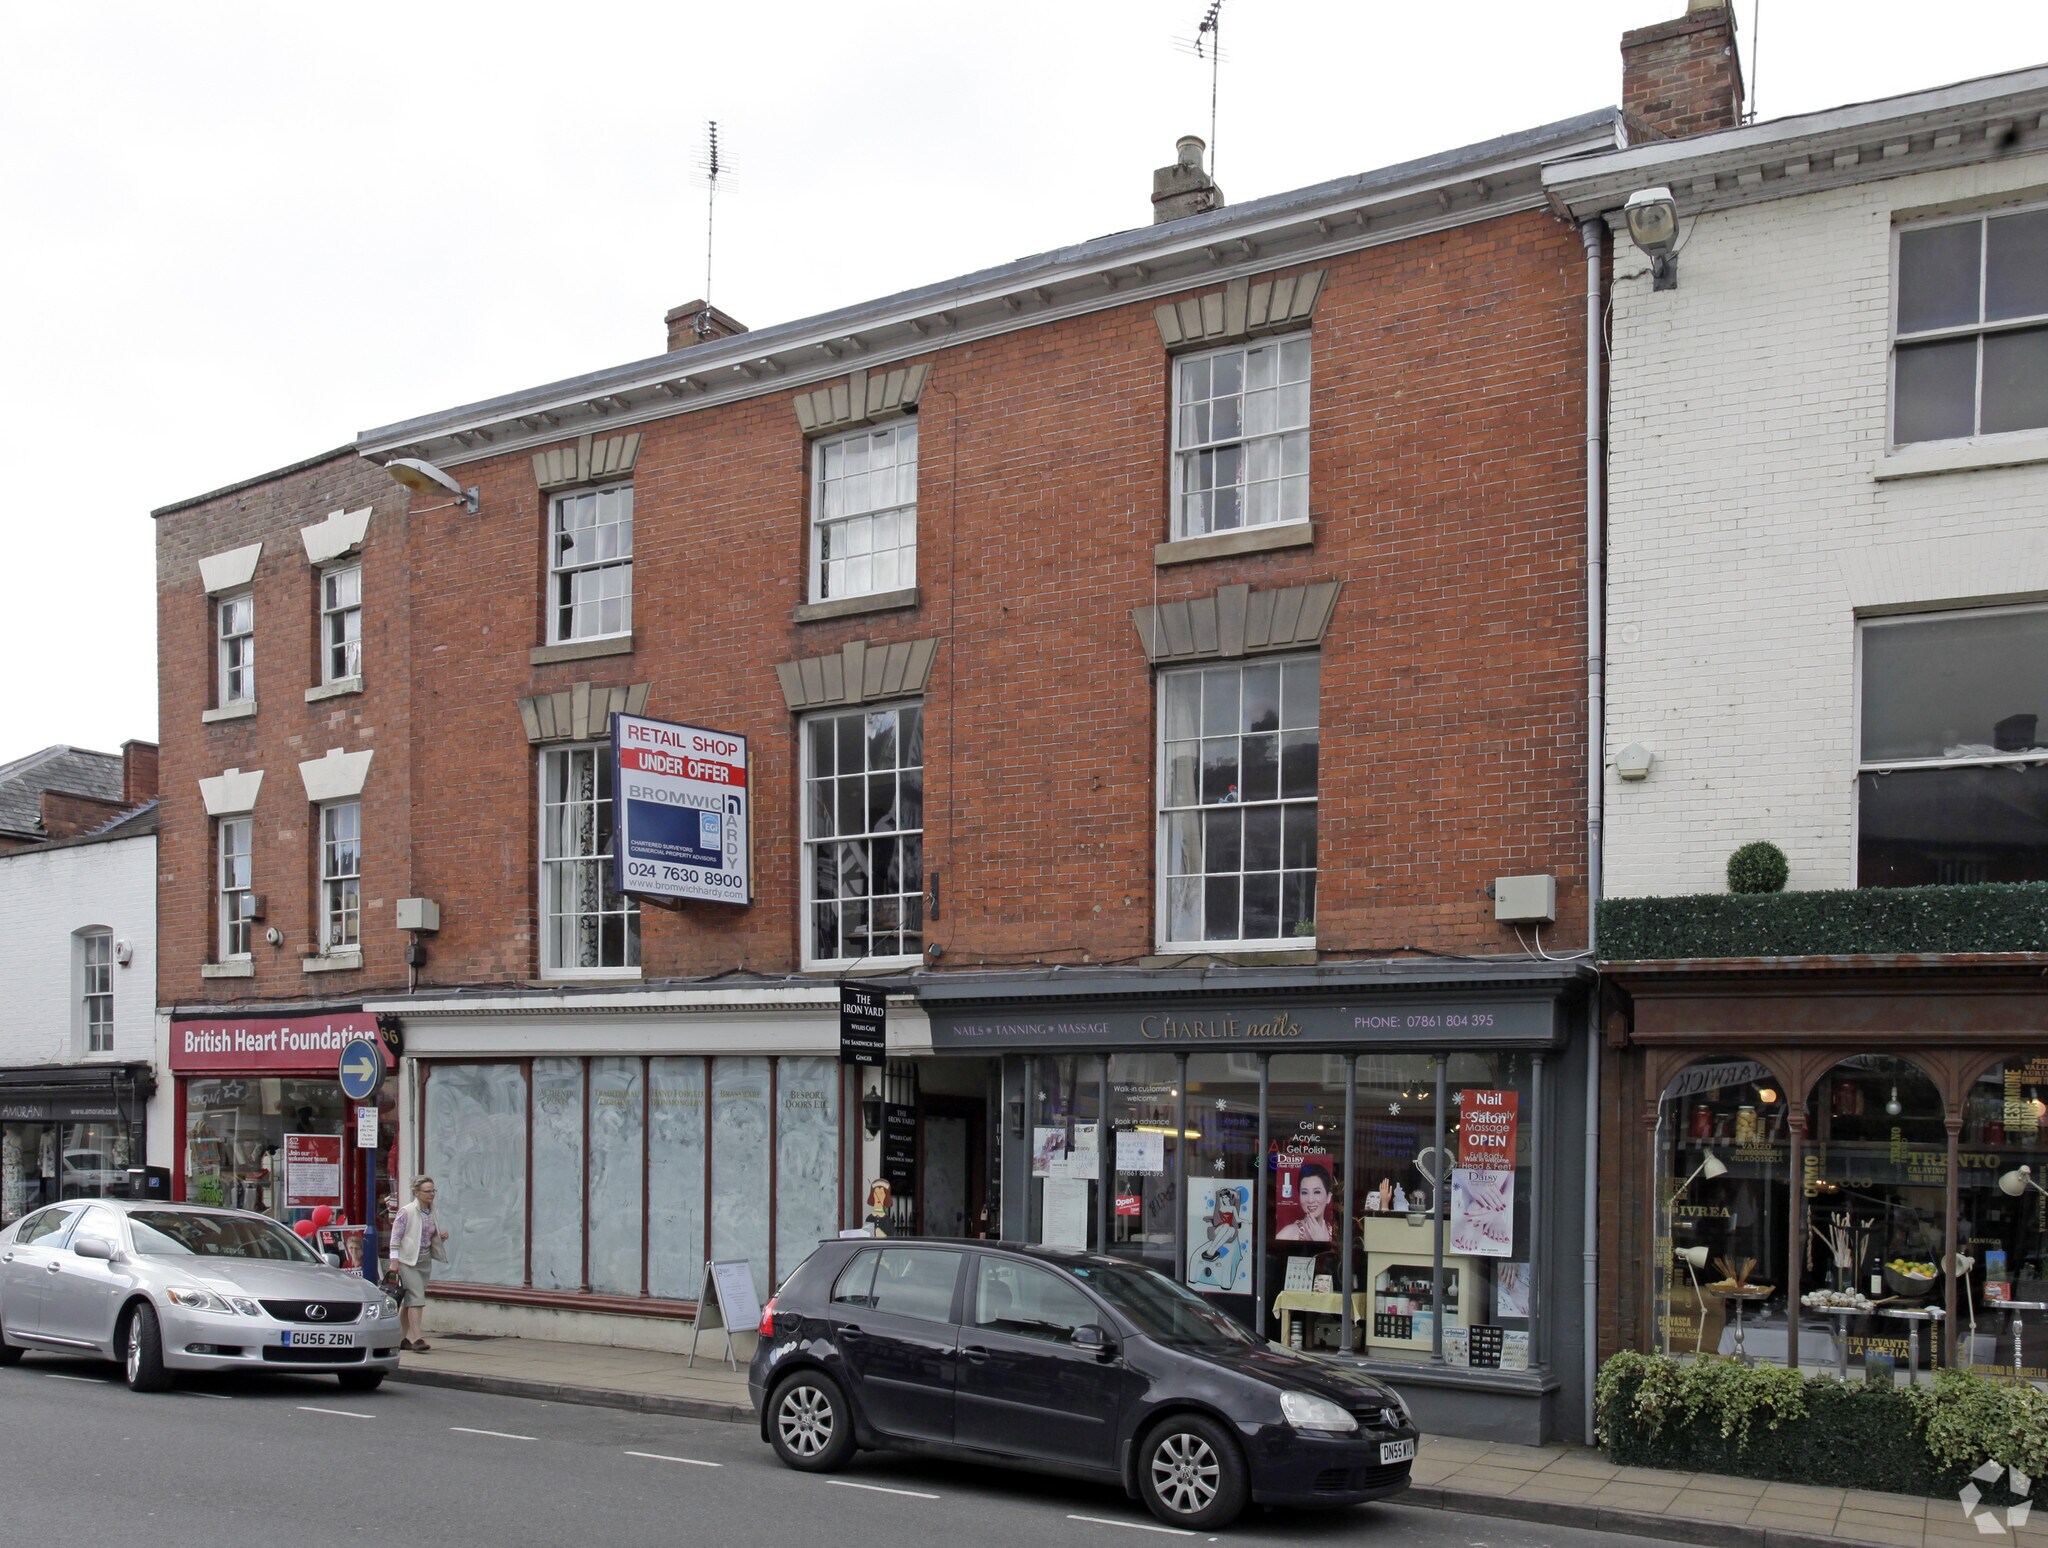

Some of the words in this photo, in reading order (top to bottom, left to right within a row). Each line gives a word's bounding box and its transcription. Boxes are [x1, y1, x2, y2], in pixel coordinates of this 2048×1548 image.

[628, 724, 686, 748] RETAIL
[692, 736, 738, 756] SHOP
[639, 752, 683, 775] UNDER
[688, 760, 729, 782] OFFER
[631, 840, 663, 849] CHARTERED
[663, 843, 694, 853] SURVEYORS
[631, 846, 665, 856] COMMERCIAL
[665, 850, 693, 859] PROPERTY
[692, 854, 717, 862] ADVISORS
[628, 862, 657, 878] 024
[662, 866, 699, 883] 7630
[704, 872, 743, 888] 8900
[628, 879, 743, 900] www.bromwichhardy.com
[855, 994, 871, 1005] THE
[843, 1003, 863, 1015] IRON
[864, 1006, 884, 1017] YARD
[1141, 1015, 1239, 1039] CHARLIE
[1246, 1012, 1302, 1037] nails
[1354, 1016, 1401, 1028] PHONE:
[1407, 1015, 1441, 1027] 07861
[1446, 1015, 1468, 1027] 804
[1472, 1014, 1493, 1026] 395
[381, 1027, 399, 1044] 66
[953, 1025, 984, 1037] NAILS
[994, 1023, 1046, 1036] TANNING
[1057, 1022, 1110, 1034] MASSAGE
[184, 1028, 231, 1053] British
[235, 1029, 277, 1051] Heart
[851, 1039, 873, 1047] SANDWICH
[855, 1054, 873, 1062] GINGER
[650, 1088, 673, 1098] HAND
[674, 1088, 704, 1098] FORGED
[790, 1090, 825, 1099] BESPOKE
[1476, 1093, 1502, 1105] Nail
[785, 1100, 812, 1109] DOORS
[2, 1105, 43, 1118] AMORANI
[896, 1109, 907, 1117] THE
[1470, 1111, 1506, 1124] Salon
[902, 1117, 915, 1126] YARD
[1299, 1121, 1315, 1130] Gel
[1465, 1123, 1510, 1134] Massage
[1292, 1134, 1321, 1143] Acrylic
[1468, 1134, 1506, 1147] OPEN
[1286, 1145, 1302, 1153] Gel
[1303, 1145, 1326, 1154] Polish
[1277, 1153, 1304, 1163] Daisy
[1483, 1152, 1504, 1160] Body
[1907, 1166, 1946, 1174] CALAVINO
[1468, 1171, 1498, 1183] Daisy
[1804, 1155, 1819, 1198] COMO
[1115, 1197, 1135, 1206] Open
[1680, 1205, 1731, 1217] IVREA
[293, 1333, 325, 1344] GU56
[329, 1334, 353, 1345] ZBN
[1866, 1337, 1909, 1349] LEVANTE
[1848, 1346, 1864, 1355] LA
[1868, 1346, 1909, 1358] SPEZIA
[1384, 1443, 1402, 1461] DN55
